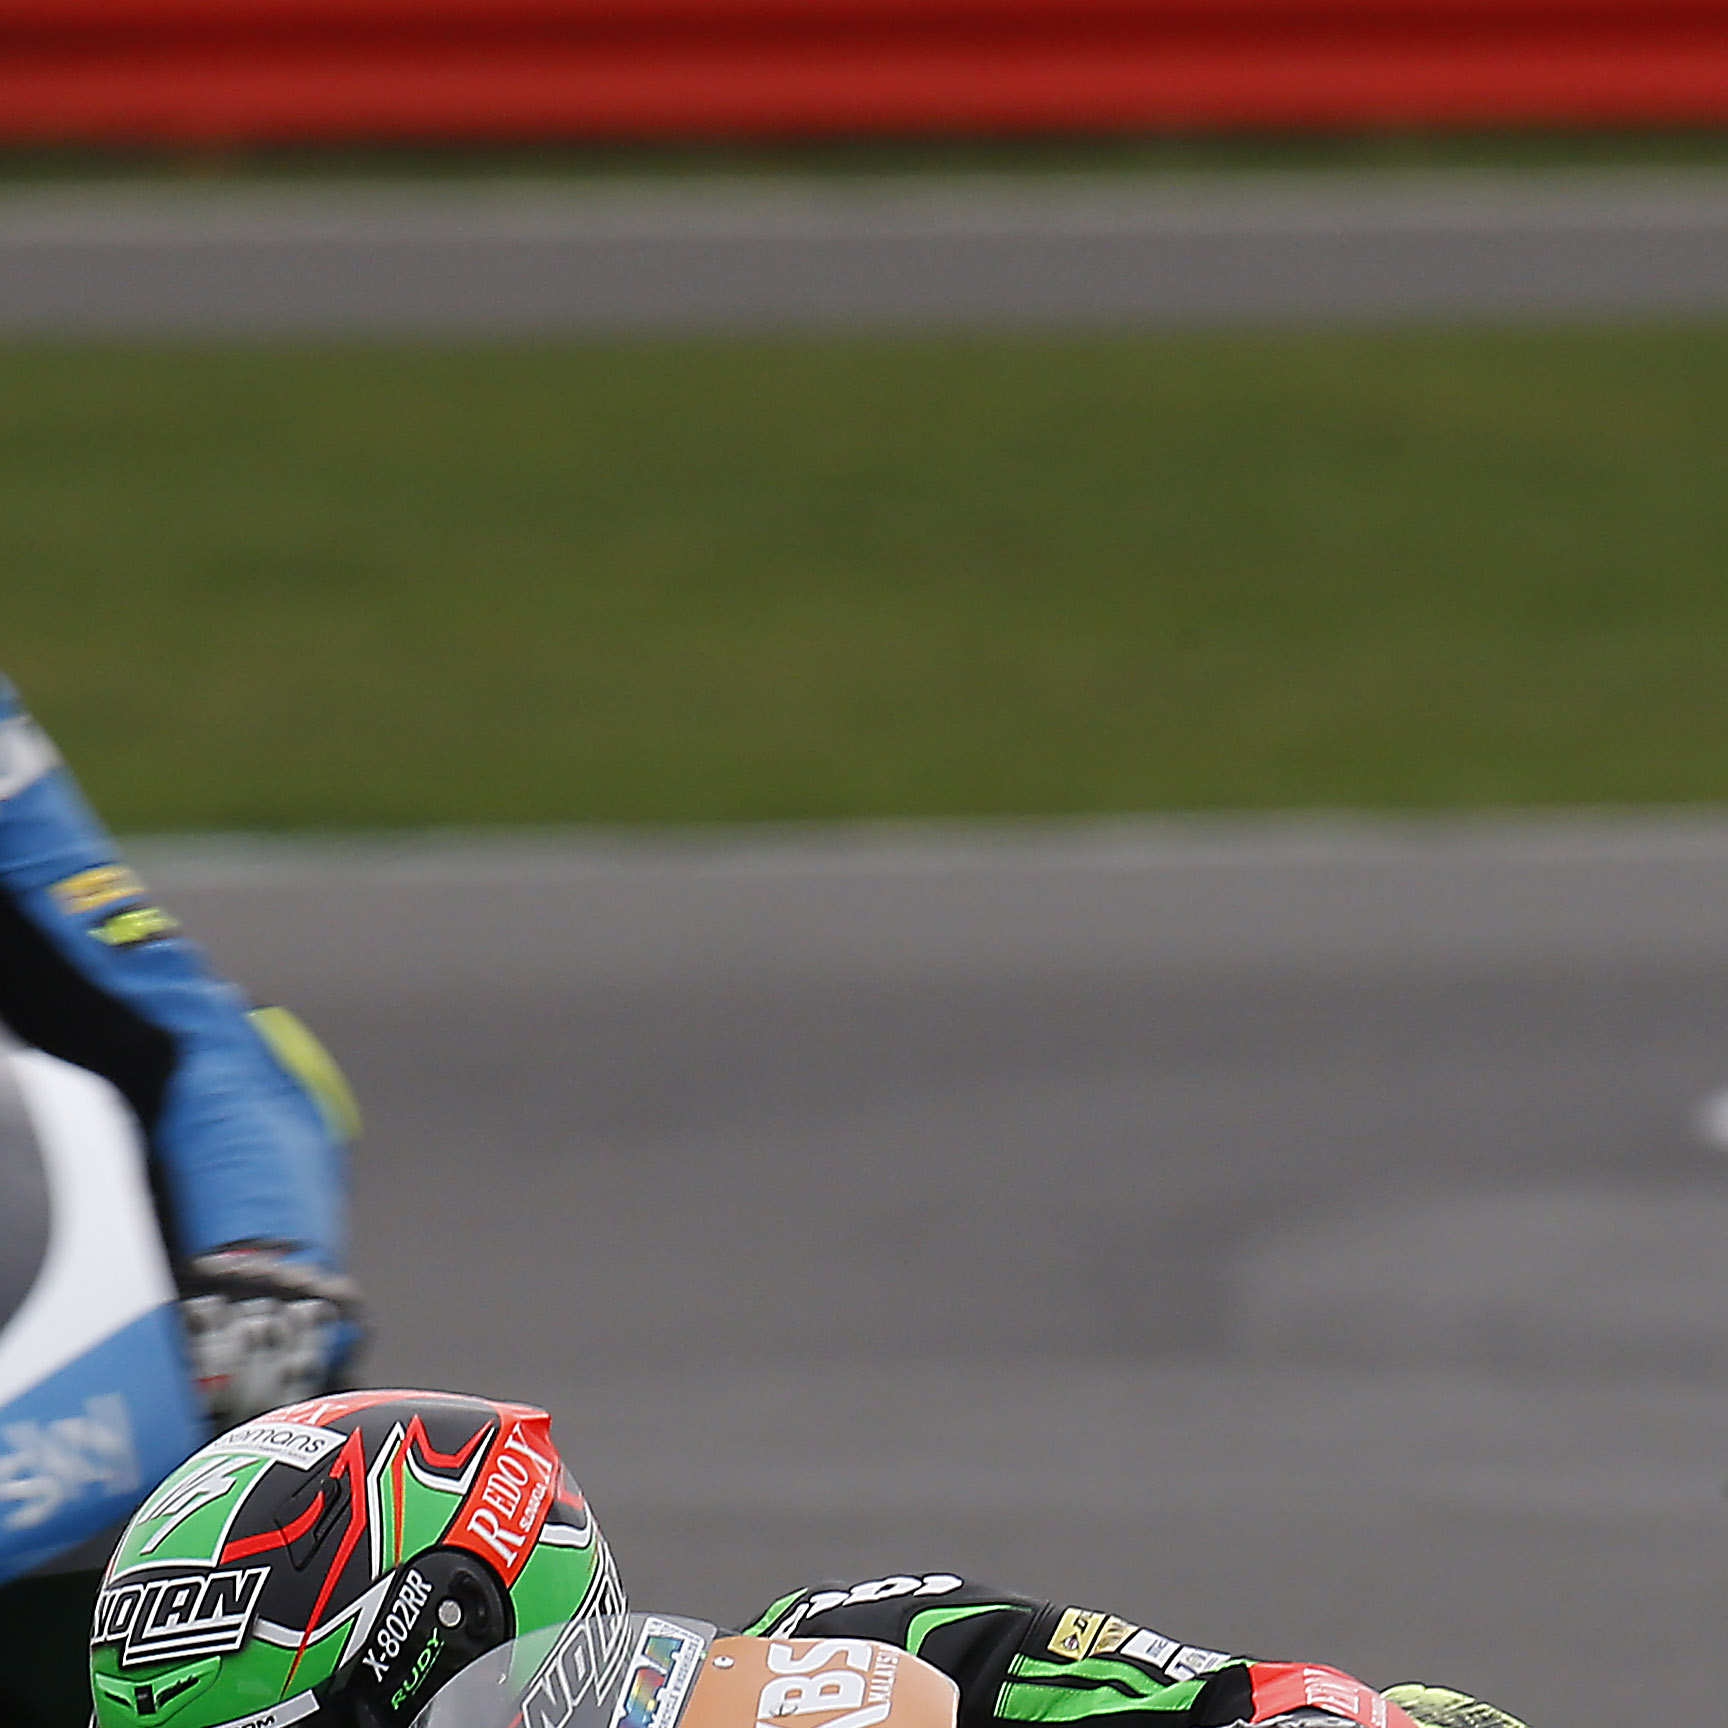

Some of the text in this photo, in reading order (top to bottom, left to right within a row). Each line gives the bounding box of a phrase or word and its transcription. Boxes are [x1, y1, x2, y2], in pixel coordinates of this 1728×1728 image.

[467, 1421, 554, 1569] REDOX
[362, 1569, 433, 1683] X-802RR
[391, 1627, 445, 1711] RUDY
